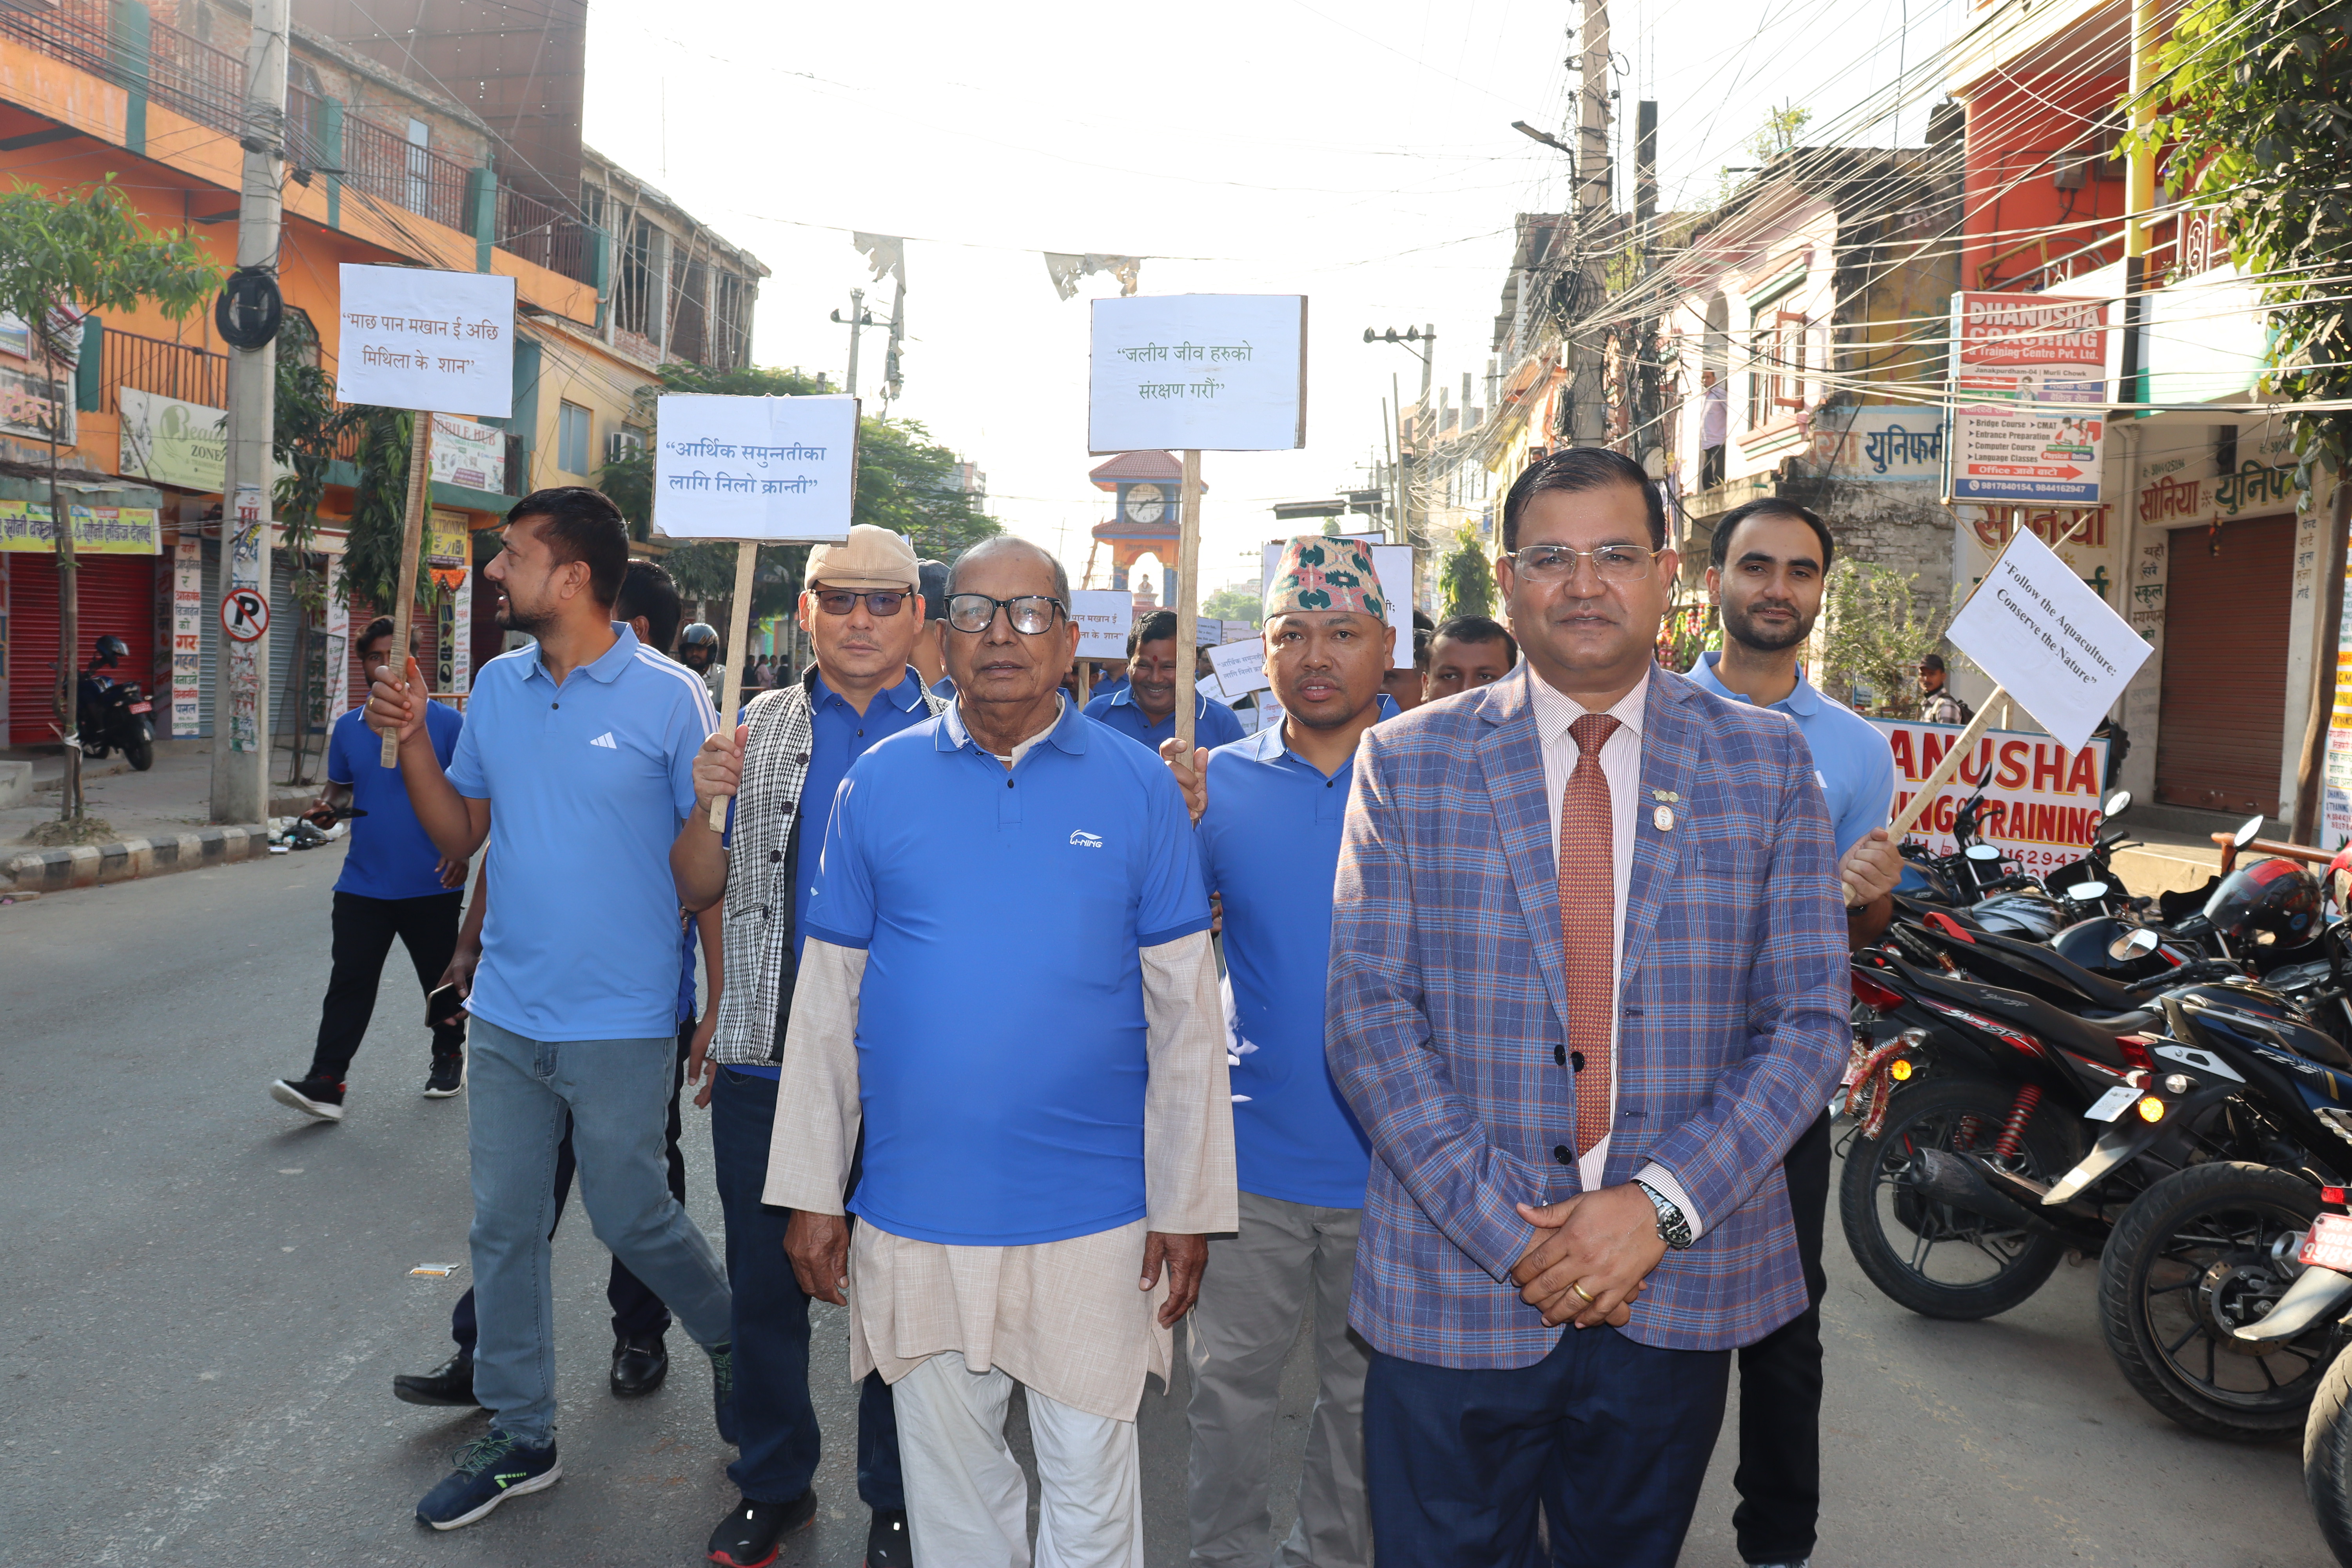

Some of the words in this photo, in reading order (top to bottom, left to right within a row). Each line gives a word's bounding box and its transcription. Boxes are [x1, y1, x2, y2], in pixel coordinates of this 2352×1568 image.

[1969, 301, 2100, 327] DHANUSHA
[343, 312, 377, 329] “माछ
[381, 316, 405, 332] पान
[408, 319, 449, 336] मखान
[452, 316, 462, 340] ई
[466, 319, 499, 340] अछि
[1969, 327, 2098, 348] COACHING
[362, 345, 411, 369] मिथिला
[414, 349, 429, 371] के
[437, 357, 475, 374] शान”
[1117, 342, 1169, 363] “जलीय
[1173, 341, 1205, 362] जीव
[1210, 340, 1253, 362] हरुको
[1980, 345, 2020, 359] Training
[2022, 347, 2055, 358] Centre
[2058, 348, 2077, 359] Pvt.
[2080, 349, 2098, 360] Ltd.
[1975, 367, 2038, 376] Janakpurdham-04
[1138, 380, 1185, 399] संरक्षण
[1190, 377, 1225, 399] गरौं”
[1976, 419, 1999, 428] Bridge
[474, 428, 495, 446] HUB
[1976, 431, 2007, 439] Entrance
[2009, 432, 2050, 440] Preparation
[191, 445, 224, 462] ZONE
[666, 437, 738, 459] “आर्थिक
[741, 442, 827, 468] समुन्नतीका
[1975, 442, 2009, 451] Computer
[1974, 454, 2009, 463] Language
[2011, 454, 2038, 463] Classes
[1978, 466, 2011, 474] Office
[2013, 466, 2035, 475] जाने
[2037, 467, 2058, 476] बाटो
[668, 470, 711, 491] लागि
[715, 471, 757, 494] निलो
[761, 475, 818, 495] क्रान्ती”
[1982, 482, 2034, 492] 9817840154,
[2036, 484, 2085, 493] 9844162947
[2140, 475, 2201, 522] सोनिया
[4, 513, 27, 542] सोनी
[82, 518, 104, 544] सोनी
[181, 575, 190, 588] र
[2135, 583, 2164, 604] स्कूल
[179, 618, 191, 630] को
[1112, 613, 1117, 624] ई
[2004, 559, 2042, 601] “Follow
[2040, 597, 2056, 617] the
[2055, 615, 2117, 677] Aquaculture:
[1092, 629, 1099, 639] के
[1996, 588, 2041, 635] Conserve
[2041, 631, 2057, 651] the
[2056, 647, 2097, 684] Nature”
[1223, 670, 1238, 680] लागि
[1238, 666, 1253, 675] निलो
[175, 704, 196, 715] पसल
[1891, 730, 2100, 797] ANUSHA
[1939, 1009, 1990, 1027] Shine
[1979, 1025, 2024, 1039] SP
